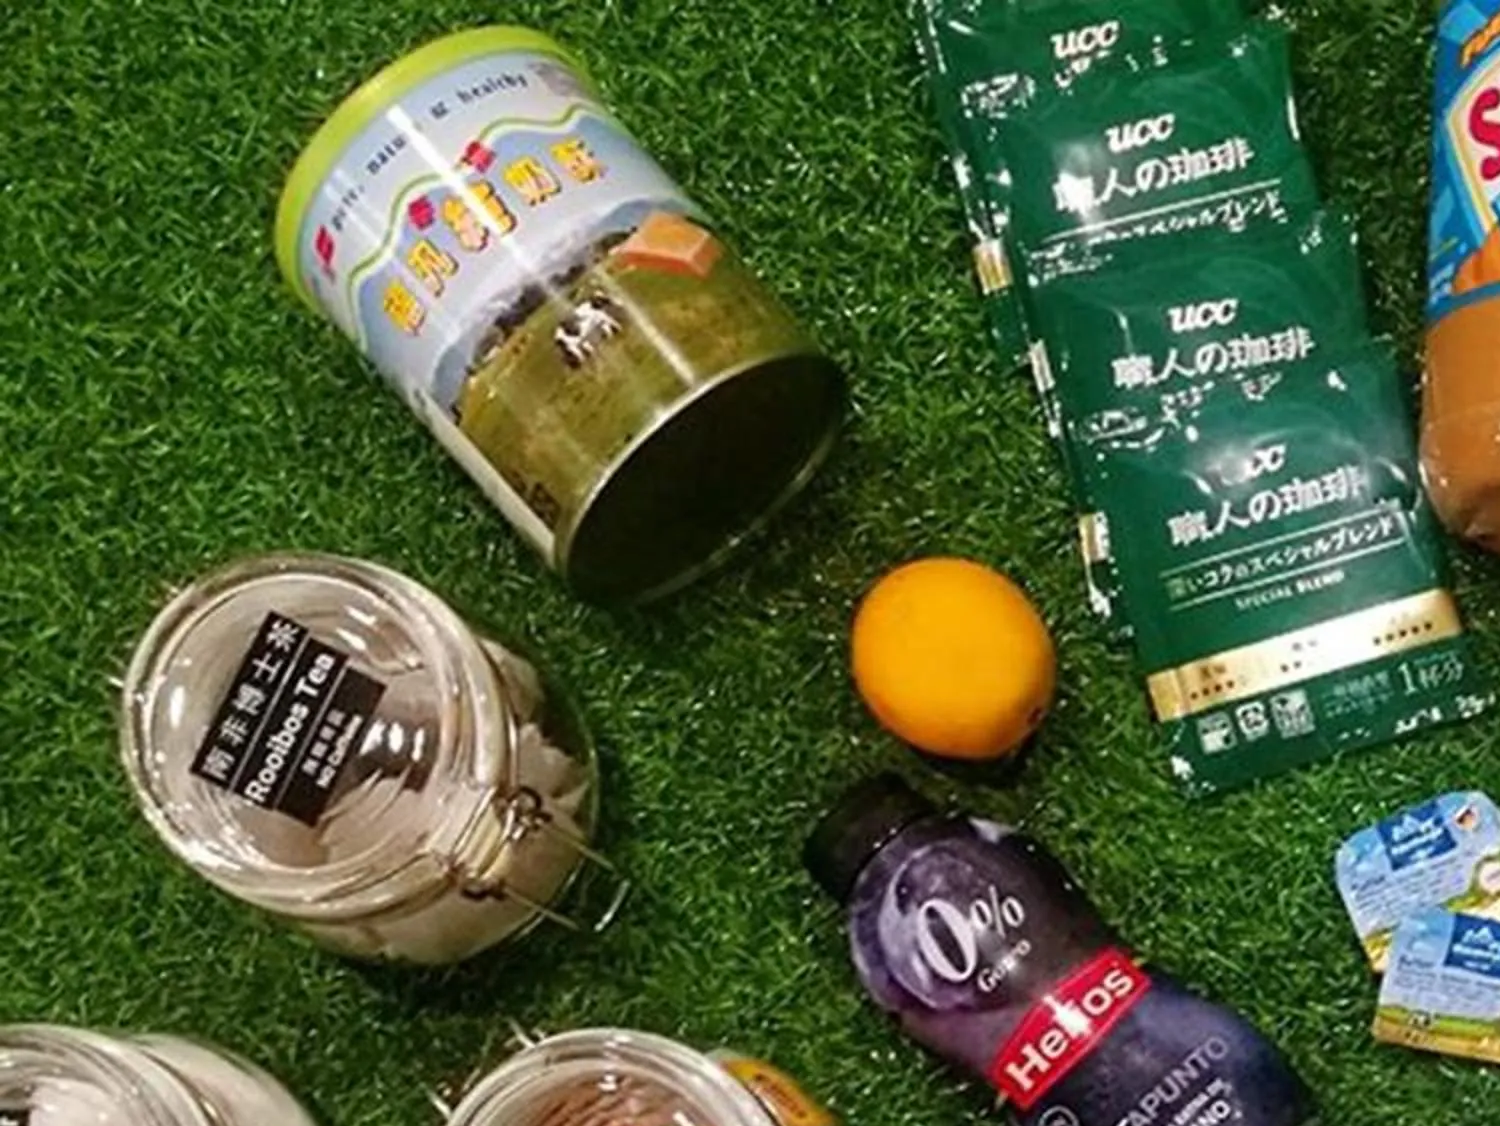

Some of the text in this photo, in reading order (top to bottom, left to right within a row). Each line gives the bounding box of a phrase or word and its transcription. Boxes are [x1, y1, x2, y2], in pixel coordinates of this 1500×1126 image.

[1053, 137, 1254, 212] 人の珈琲
[244, 653, 335, 802] Rooibos Tea
[917, 884, 1024, 982] 0%
